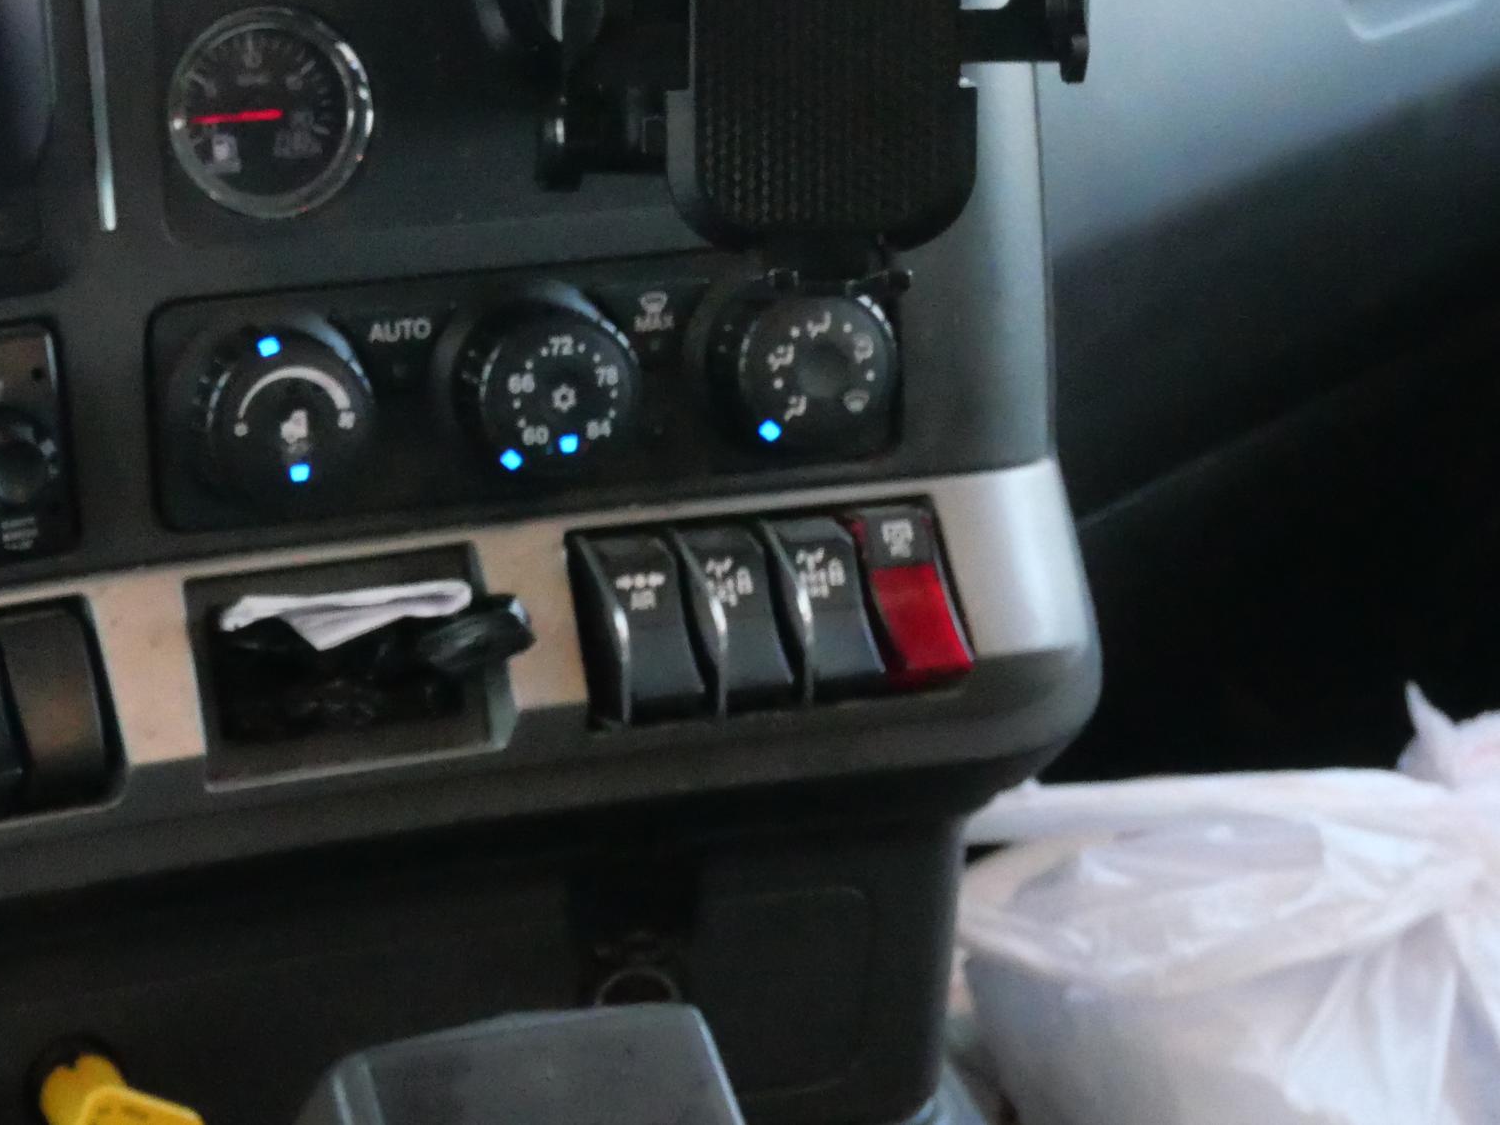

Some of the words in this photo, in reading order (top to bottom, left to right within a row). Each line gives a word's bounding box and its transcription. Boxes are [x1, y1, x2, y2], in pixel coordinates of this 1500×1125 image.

[368, 316, 432, 343] AUTO
[549, 334, 575, 357] 72
[507, 373, 536, 394] 66
[521, 425, 550, 446] 60
